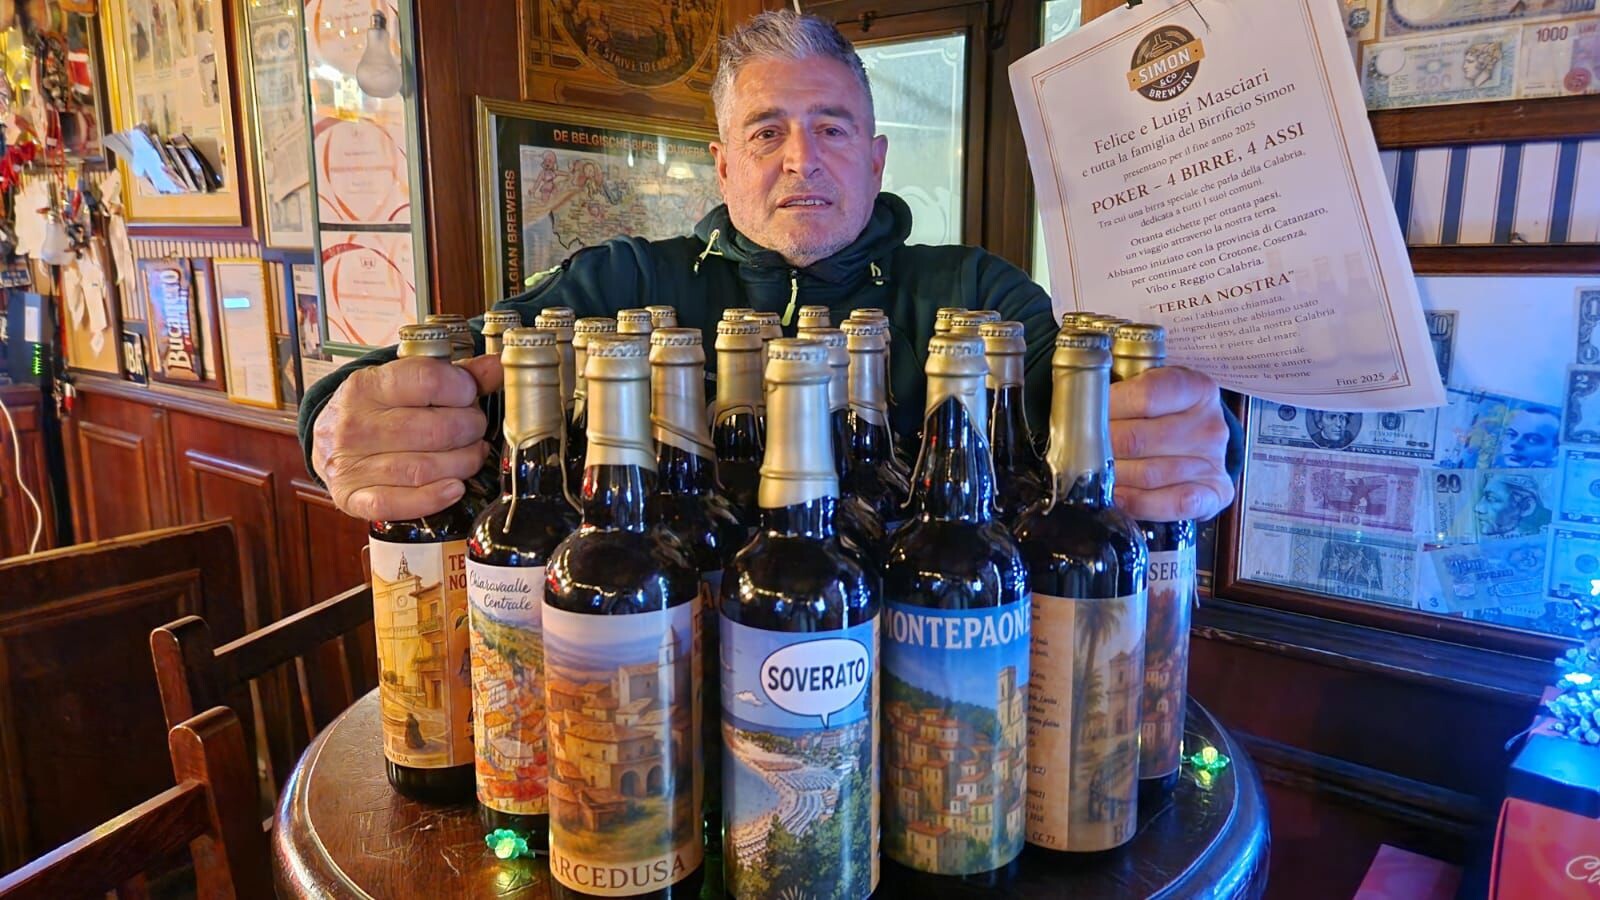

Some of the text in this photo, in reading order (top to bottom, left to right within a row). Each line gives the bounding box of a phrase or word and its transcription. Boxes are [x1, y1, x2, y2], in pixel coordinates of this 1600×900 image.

[1536, 26, 1569, 42] 1000
[1138, 47, 1191, 84] SIMON
[1148, 71, 1193, 99] BREWERY
[1093, 67, 1270, 154] Felice e Luigi Masciari
[553, 128, 570, 144] DE
[571, 133, 632, 152] BELGISCHE
[1082, 82, 1296, 178] e tutta la famiglia del Birrificio Simon
[1091, 184, 1150, 215] POKER
[1166, 173, 1178, 187] 4
[1181, 149, 1243, 182] BIRRE,
[1246, 141, 1258, 155] 4
[1263, 121, 1306, 151] ASSI
[1123, 120, 1257, 182] presentano per il fine anno 2025
[504, 169, 518, 244] BREWERS
[1098, 220, 1113, 231] Tra
[1113, 213, 1128, 225] cui
[1128, 208, 1144, 220] una
[1144, 199, 1166, 215] birra
[1166, 187, 1199, 208] speciale
[1200, 180, 1216, 194] che
[1216, 173, 1240, 191] parla
[1240, 163, 1262, 180] della
[1140, 210, 1174, 228] dedicata
[1182, 200, 1202, 215] tutti
[1208, 190, 1228, 204] suoi
[1125, 206, 1277, 261] un viaggio attraverso la nostra terra
[1129, 230, 1164, 248] Ottanta
[1165, 217, 1202, 237] etichette
[1202, 211, 1218, 226] per
[1218, 201, 1253, 218] ottanta
[1107, 263, 1148, 280] Abbiamo
[1149, 252, 1185, 269] iniziato
[1185, 247, 1204, 259] con
[1204, 242, 1215, 254] la
[1215, 228, 1261, 252] provincia
[1261, 223, 1273, 235] di
[1131, 275, 1146, 289] per
[1147, 262, 1198, 283] continuare
[1198, 257, 1217, 270] con
[1145, 281, 1169, 296] Vibo
[1178, 270, 1215, 289] Reggio
[1181, 318, 1231, 335] ingredienti
[1231, 312, 1249, 325] che
[1250, 305, 1293, 322] abbiamo
[1293, 297, 1319, 312] usato
[1192, 333, 1208, 344] per
[1208, 331, 1217, 340] il
[1238, 322, 1262, 336] dalla
[1263, 318, 1293, 331] nostra
[1294, 308, 1336, 325] Calabria
[1227, 338, 1256, 349] pietre
[1256, 334, 1272, 344] del
[1231, 361, 1272, 371] passione
[1262, 371, 1273, 380] le
[1274, 370, 1312, 381] persone
[1335, 371, 1386, 387] Fine 2025
[1436, 473, 1462, 494] 20
[483, 593, 533, 611] Centrale
[1429, 597, 1439, 608] 3
[883, 604, 1031, 650] MONTEPAONE
[767, 656, 866, 693] SOVERATO
[551, 848, 685, 889] ARCEDUSA
